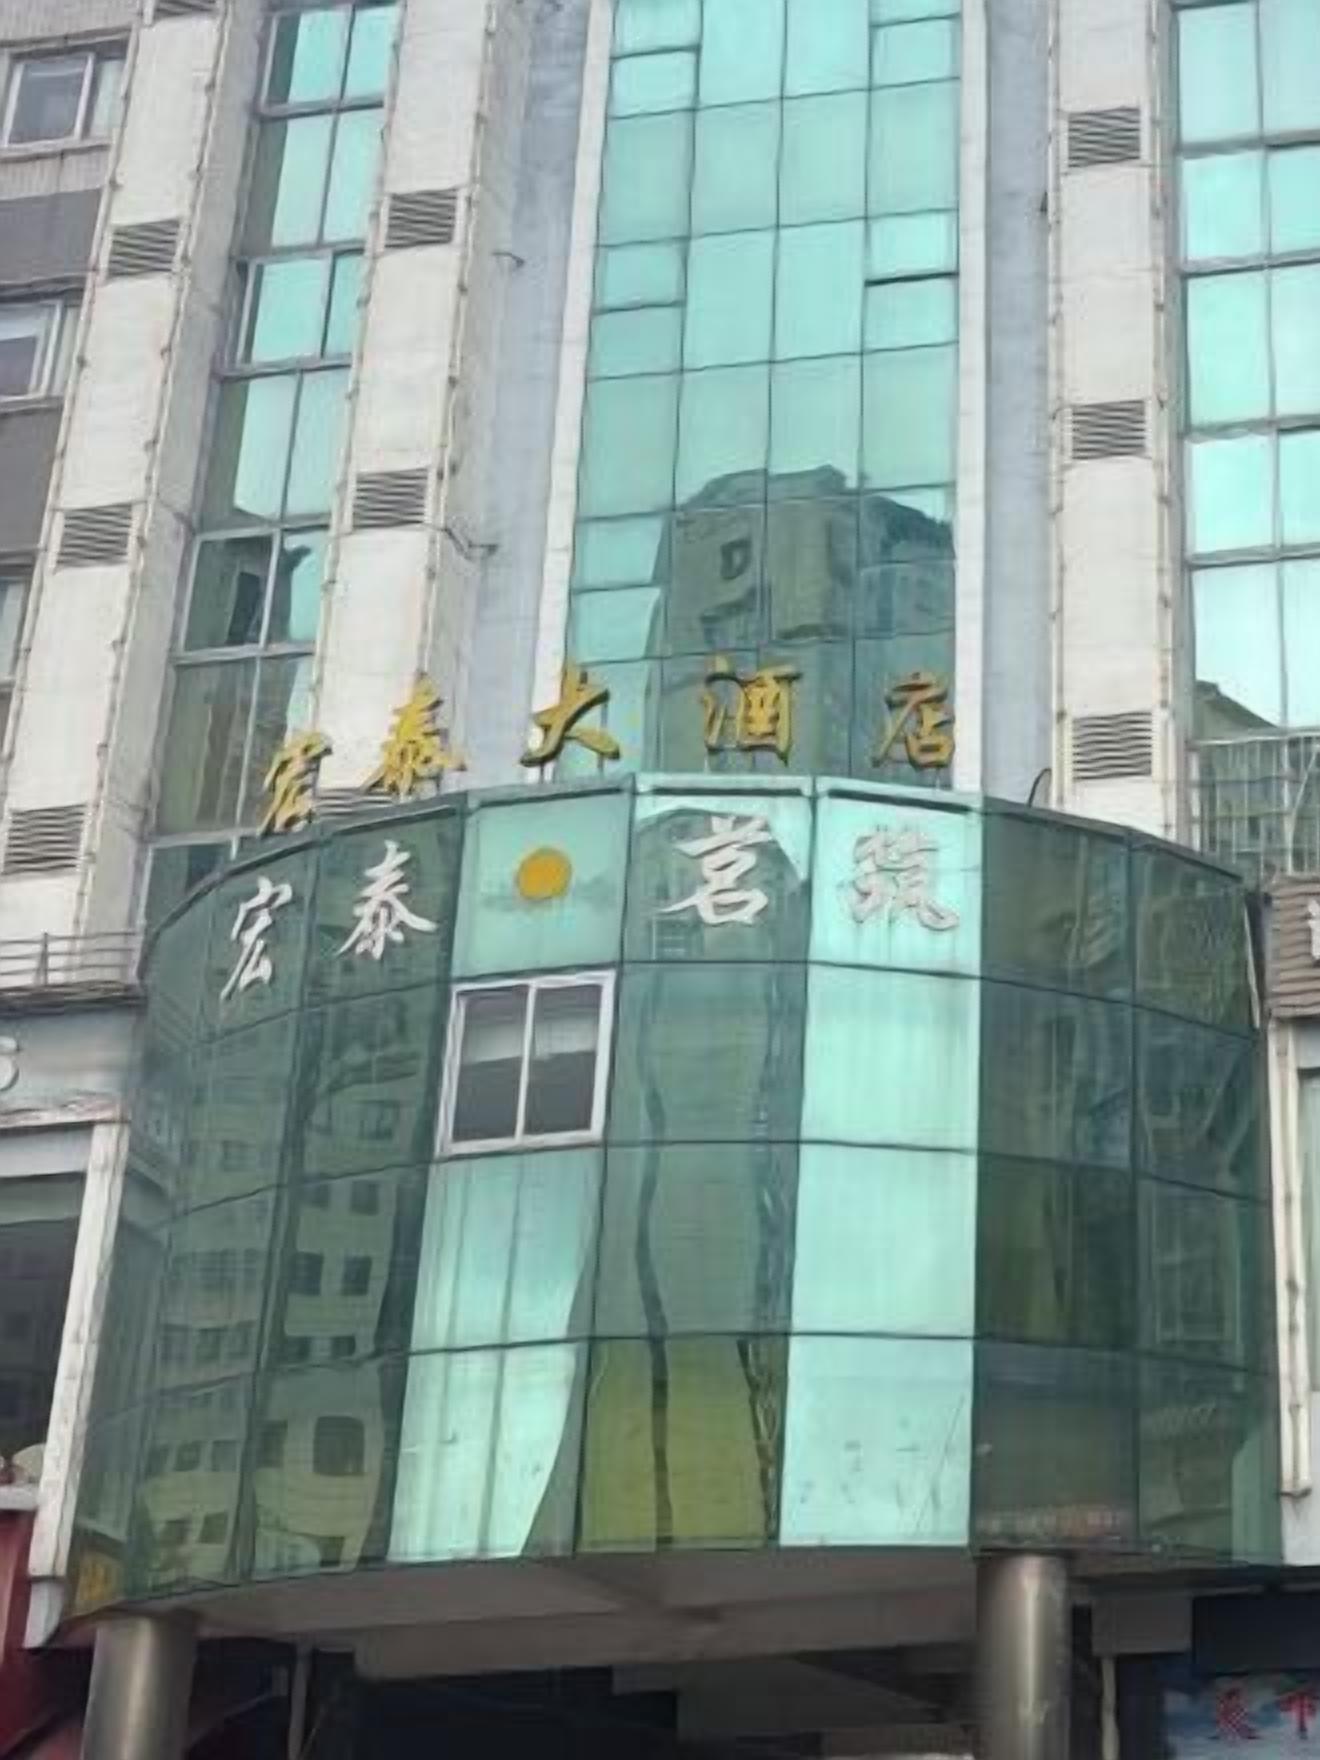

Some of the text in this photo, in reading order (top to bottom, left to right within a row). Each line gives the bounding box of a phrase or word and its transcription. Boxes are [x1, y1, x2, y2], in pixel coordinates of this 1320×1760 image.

[261, 657, 957, 837] 宏泰大酒店
[220, 840, 438, 1001] 宏泰
